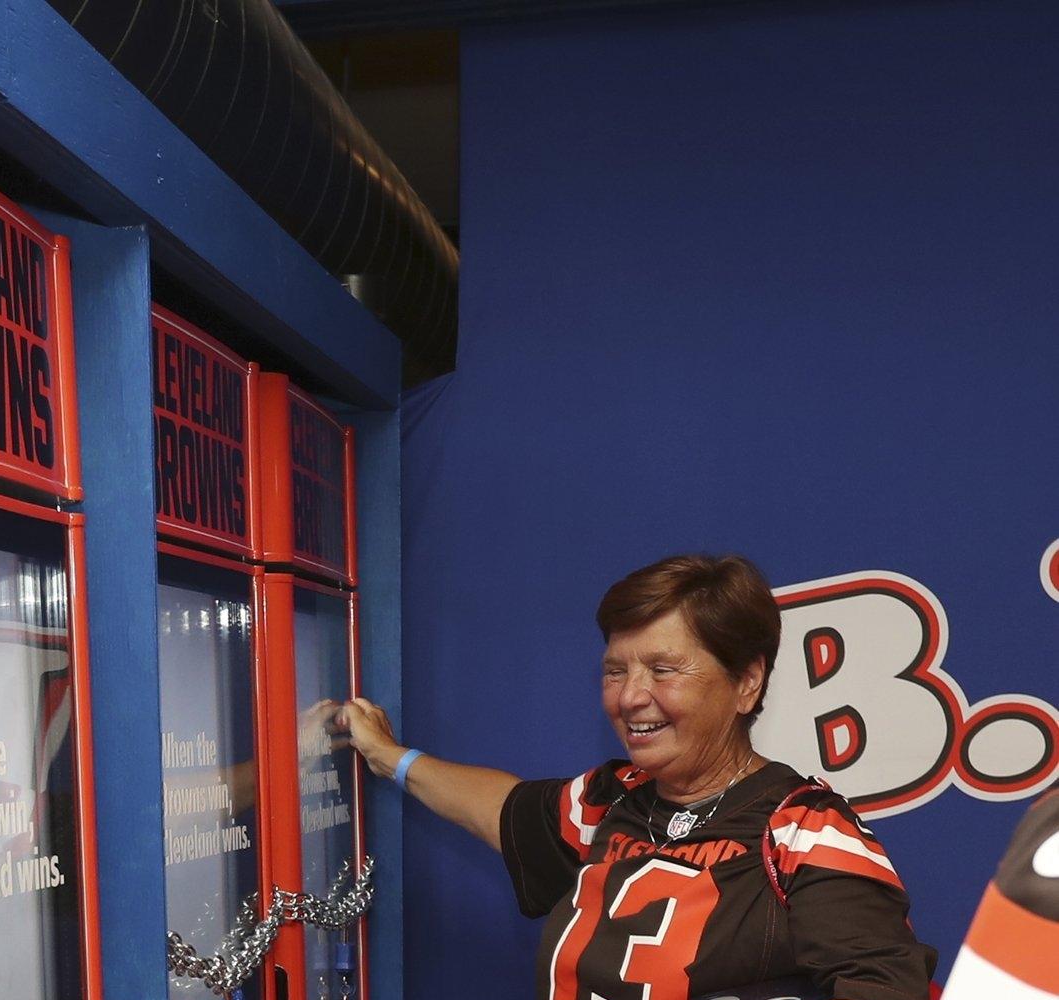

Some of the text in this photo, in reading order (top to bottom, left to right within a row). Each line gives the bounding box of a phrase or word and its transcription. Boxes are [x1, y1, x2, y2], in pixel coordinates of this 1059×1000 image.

[152, 327, 243, 444] LEVELAND
[197, 732, 216, 766] the
[208, 776, 233, 816] win,
[222, 818, 251, 853] wins.
[17, 846, 65, 893] wins.
